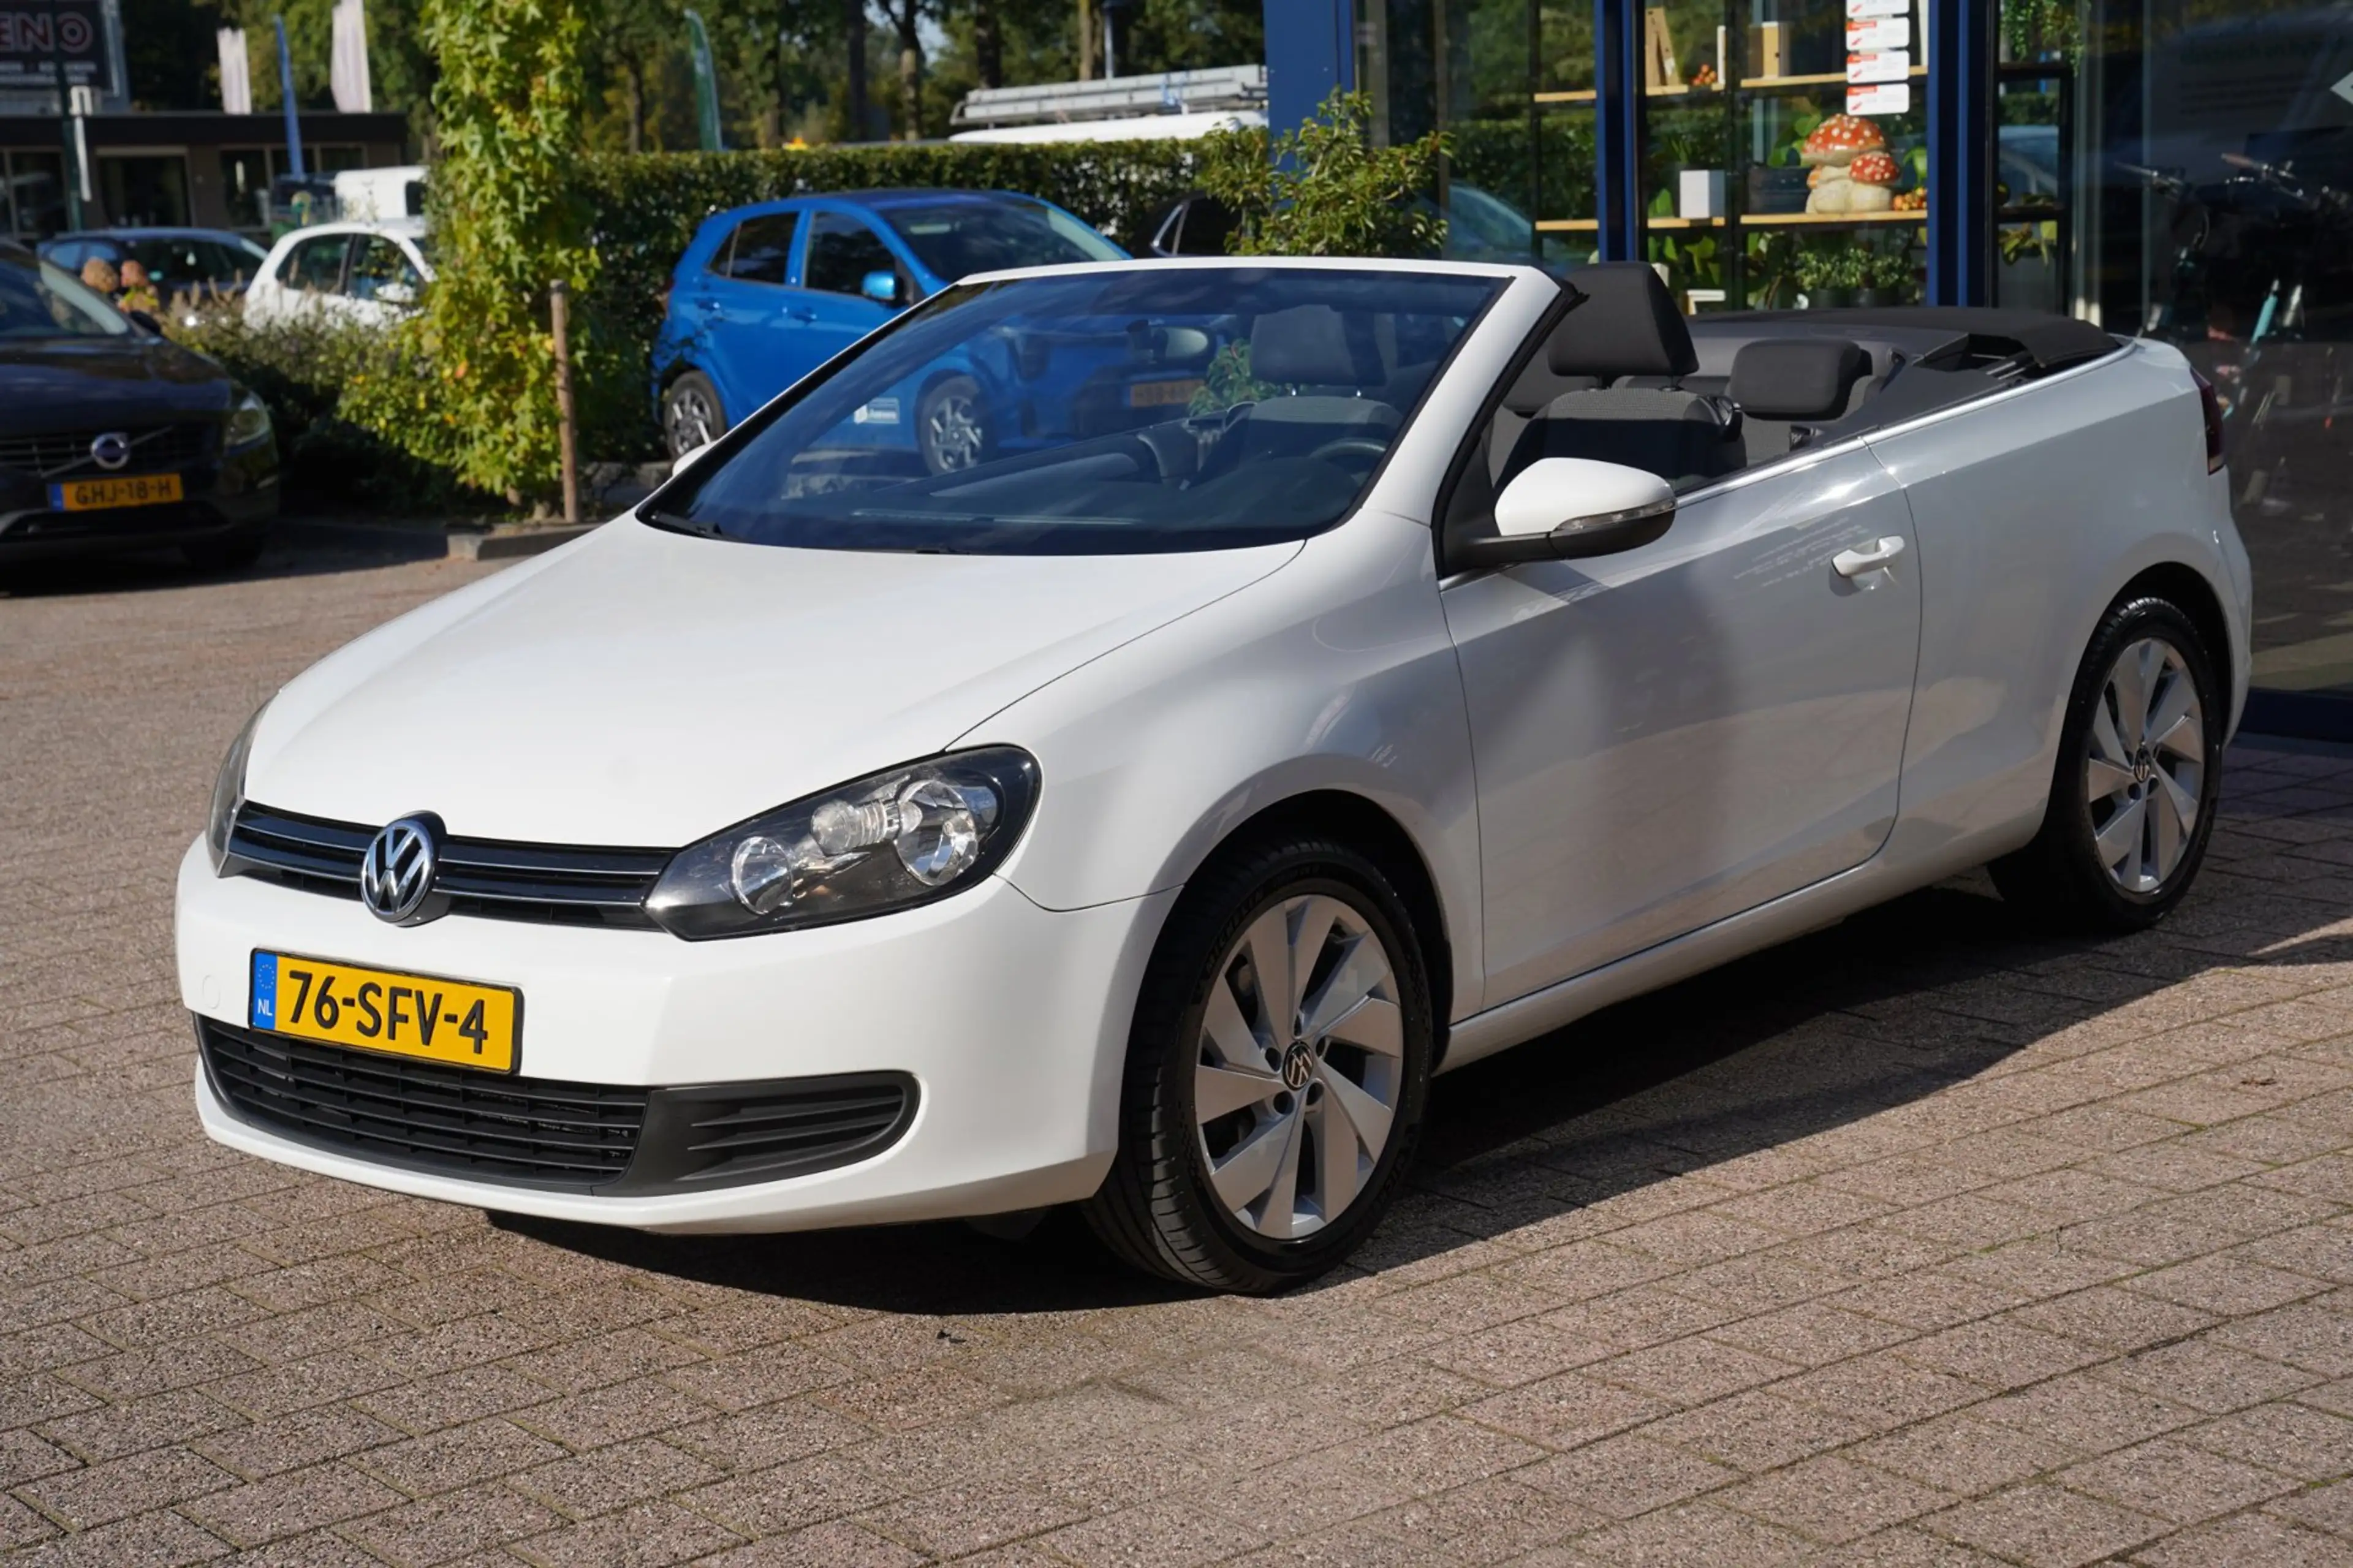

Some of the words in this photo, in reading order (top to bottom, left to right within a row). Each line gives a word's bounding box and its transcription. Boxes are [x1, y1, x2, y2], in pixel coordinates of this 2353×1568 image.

[75, 477, 172, 506] GHJ-18-H
[257, 998, 273, 1017] NL
[289, 969, 488, 1055] 76-SFV-4
